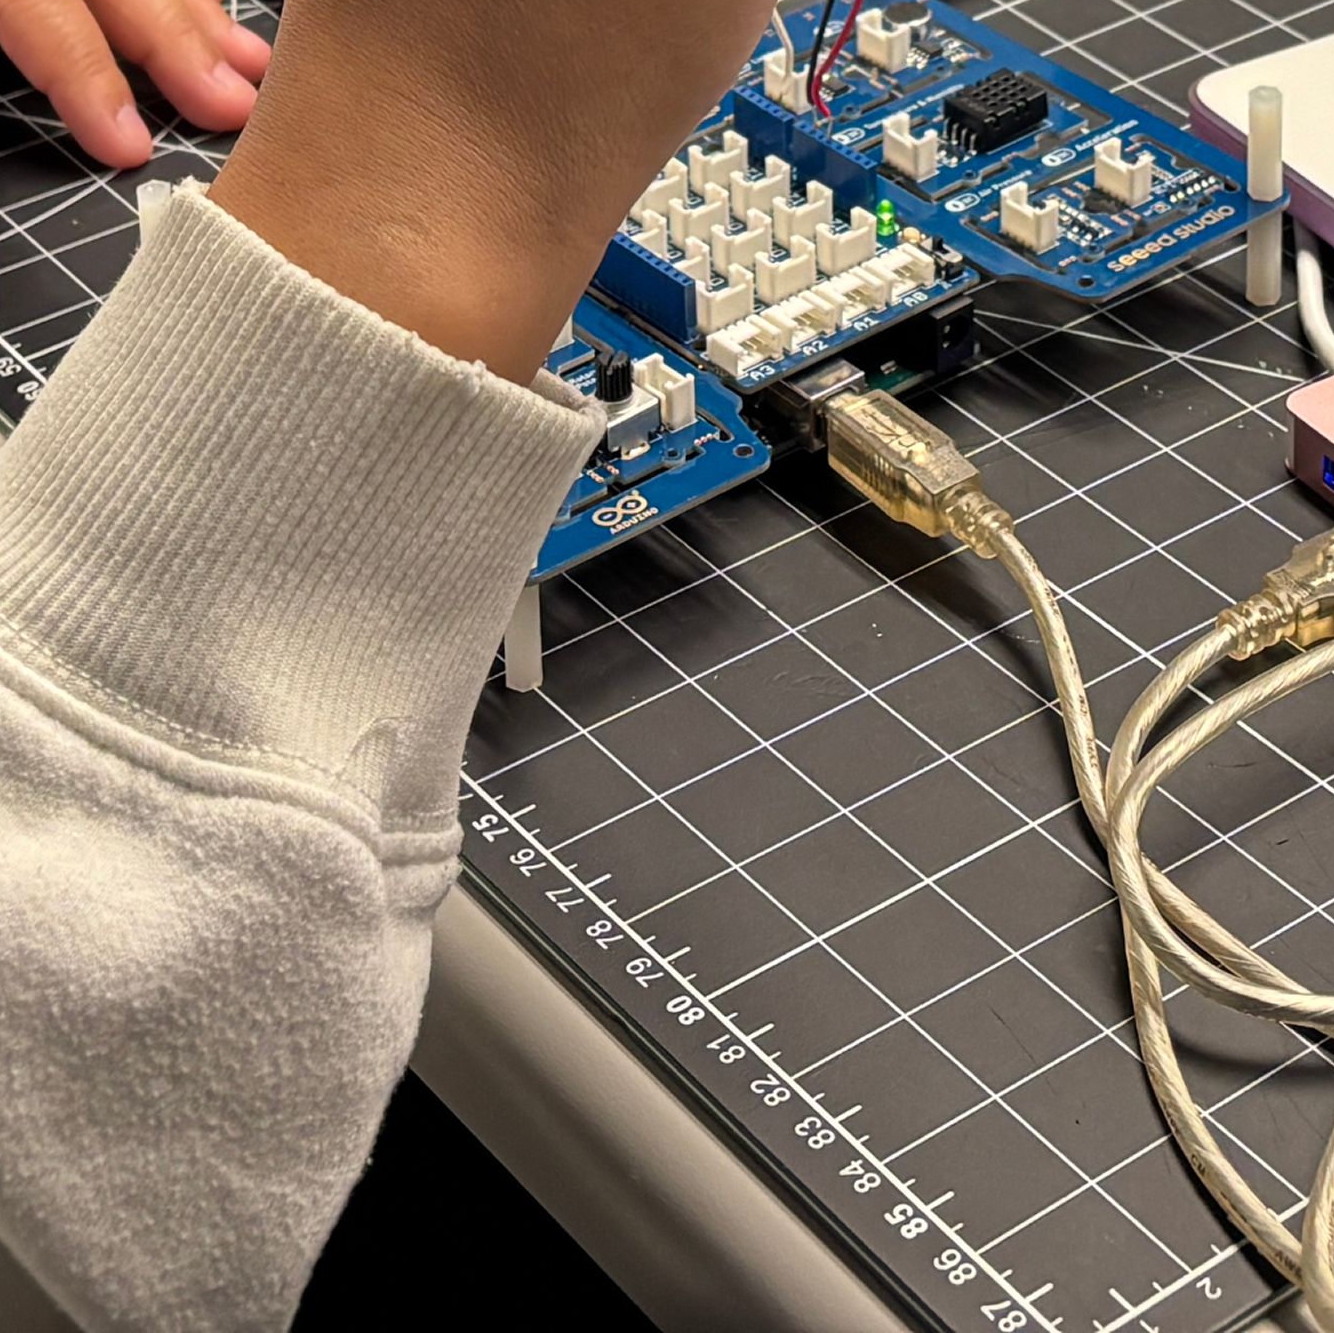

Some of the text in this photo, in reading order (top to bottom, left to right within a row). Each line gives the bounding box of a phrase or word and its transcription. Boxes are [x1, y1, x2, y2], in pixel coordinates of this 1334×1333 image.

[1074, 119, 1139, 153] Acceleration
[1107, 204, 1236, 273] seeed studio
[902, 290, 929, 309] A0
[853, 316, 881, 332] A1
[802, 340, 829, 357] A2
[749, 364, 776, 381] A3
[609, 506, 660, 535] ARDUINO
[471, 812, 509, 843] 75
[509, 848, 547, 877] 76
[544, 886, 585, 913] 77
[585, 919, 624, 950] 78
[625, 956, 665, 988] 79
[665, 994, 705, 1026] 80
[705, 1033, 746, 1064] 81
[750, 1073, 792, 1107] 82
[794, 1115, 836, 1149] 83
[838, 1158, 882, 1194] 84
[883, 1203, 929, 1240] 85
[933, 1248, 977, 1286] 86
[1195, 1276, 1222, 1300] 2
[979, 1299, 1028, 1333] 87
